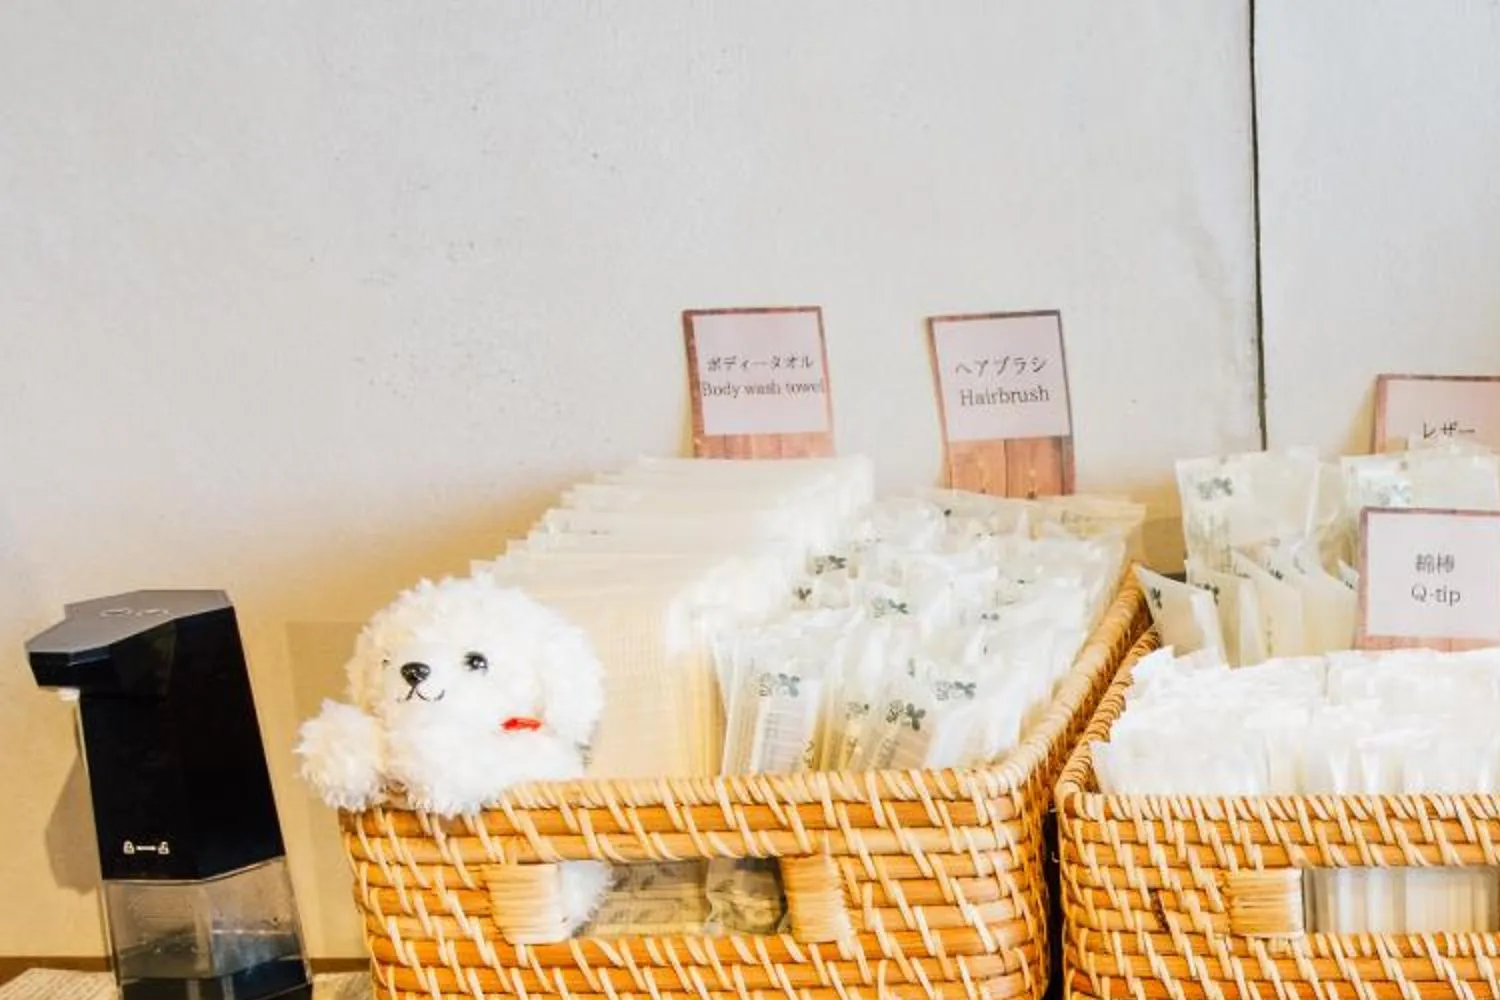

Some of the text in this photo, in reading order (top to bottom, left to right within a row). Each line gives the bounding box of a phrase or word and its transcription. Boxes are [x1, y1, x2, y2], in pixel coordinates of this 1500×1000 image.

[706, 355, 815, 373] ボディータオル
[955, 355, 1047, 377] ヘアブラシ
[702, 378, 824, 399] Body wash towel
[960, 384, 1050, 406] Hairbrush
[1423, 421, 1476, 439] レザー
[1415, 552, 1455, 575] 綿棒
[1410, 583, 1461, 607] Q-tip
